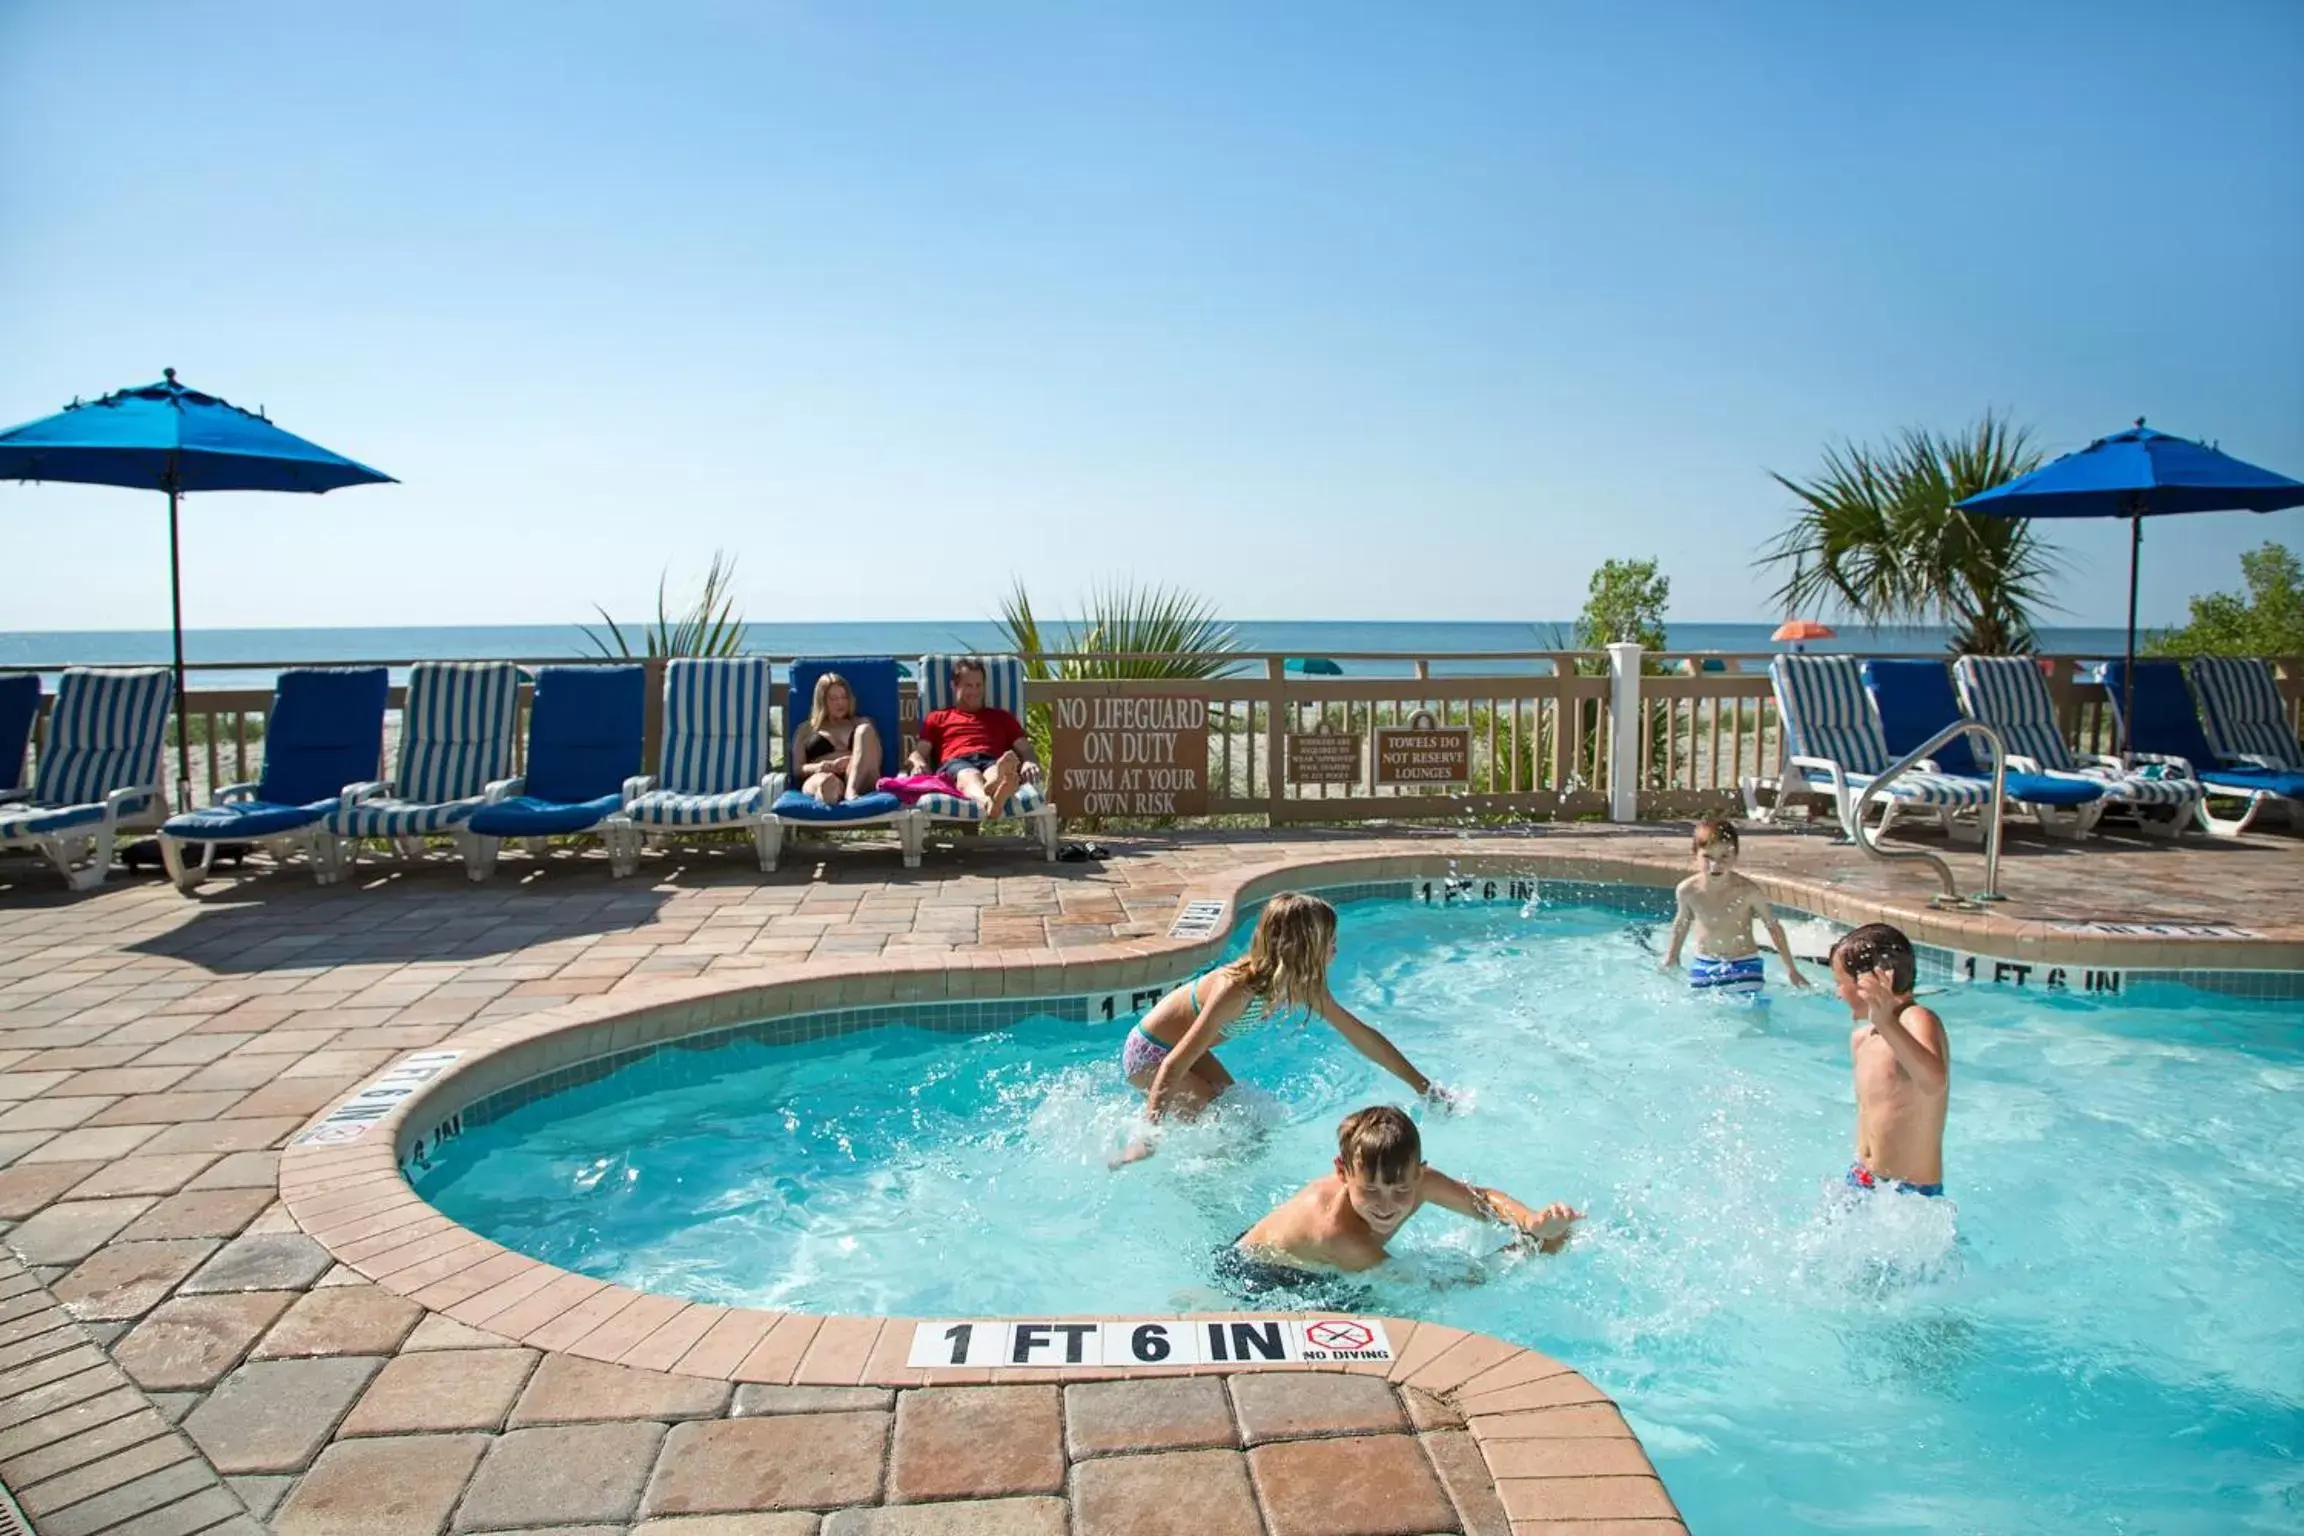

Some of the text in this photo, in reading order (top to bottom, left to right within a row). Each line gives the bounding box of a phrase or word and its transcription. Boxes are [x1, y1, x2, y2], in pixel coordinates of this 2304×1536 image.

[1057, 698, 1204, 729] NO LIFEGUARD
[1084, 732, 1177, 763] ON DUTY
[1388, 736, 1460, 749] TOWELS DO
[1381, 752, 1464, 764] NOT RESERVE
[1064, 769, 1197, 790] SWIM AT YOUR
[1396, 767, 1452, 779] LOUNGES
[1084, 793, 1176, 814] OWN RISK
[1422, 881, 1431, 904] 1
[1483, 880, 1497, 900] 6
[1509, 880, 1534, 900] IN
[1964, 956, 2119, 993] 1 FT 6 IN
[1101, 987, 1163, 1021] 1 FT
[326, 1103, 396, 1123] IN
[944, 1322, 1287, 1365] 1 FT 6 IN
[1303, 1350, 1389, 1360] NO DIVING
